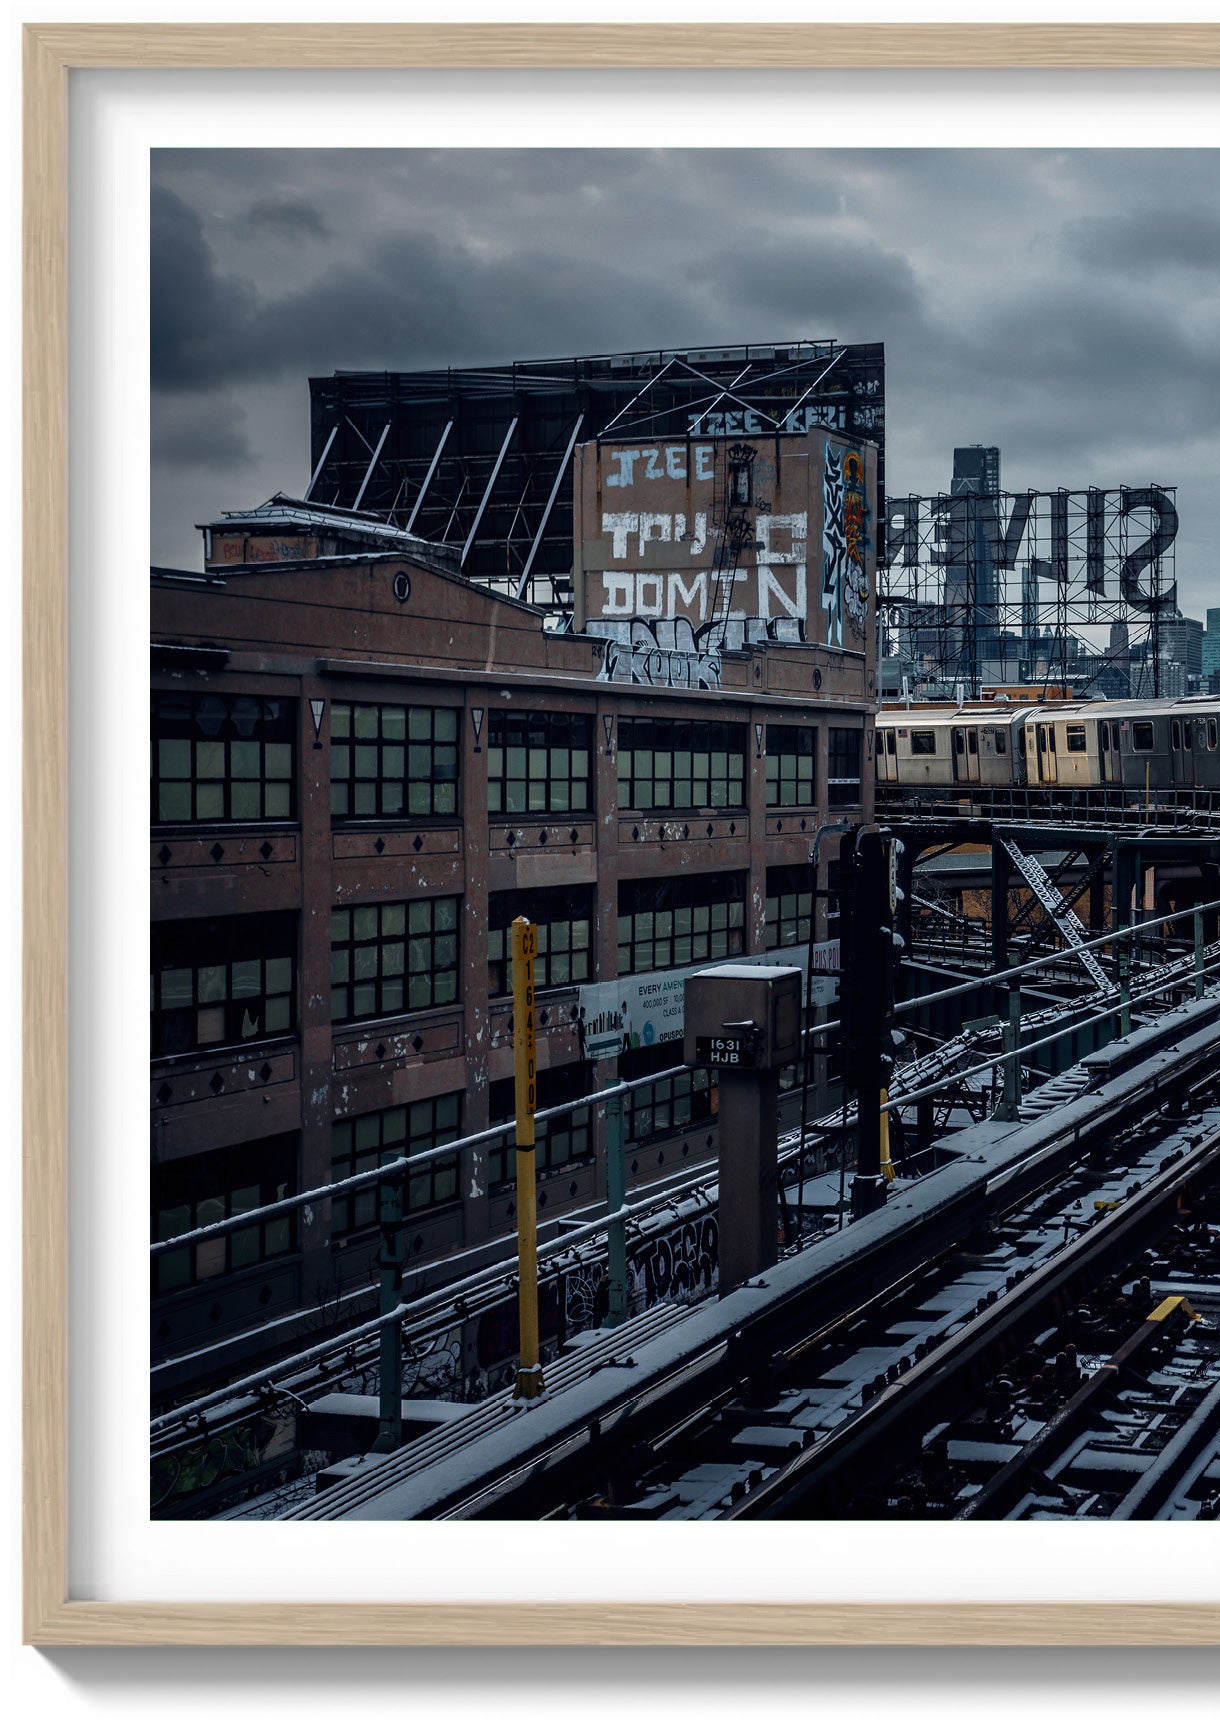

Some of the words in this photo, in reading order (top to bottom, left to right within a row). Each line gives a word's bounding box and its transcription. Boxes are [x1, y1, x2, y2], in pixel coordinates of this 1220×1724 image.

[522, 933, 534, 955] C2
[638, 983, 661, 995] EVERY
[710, 1039, 740, 1051] 1631
[710, 1051, 740, 1064] HJB
